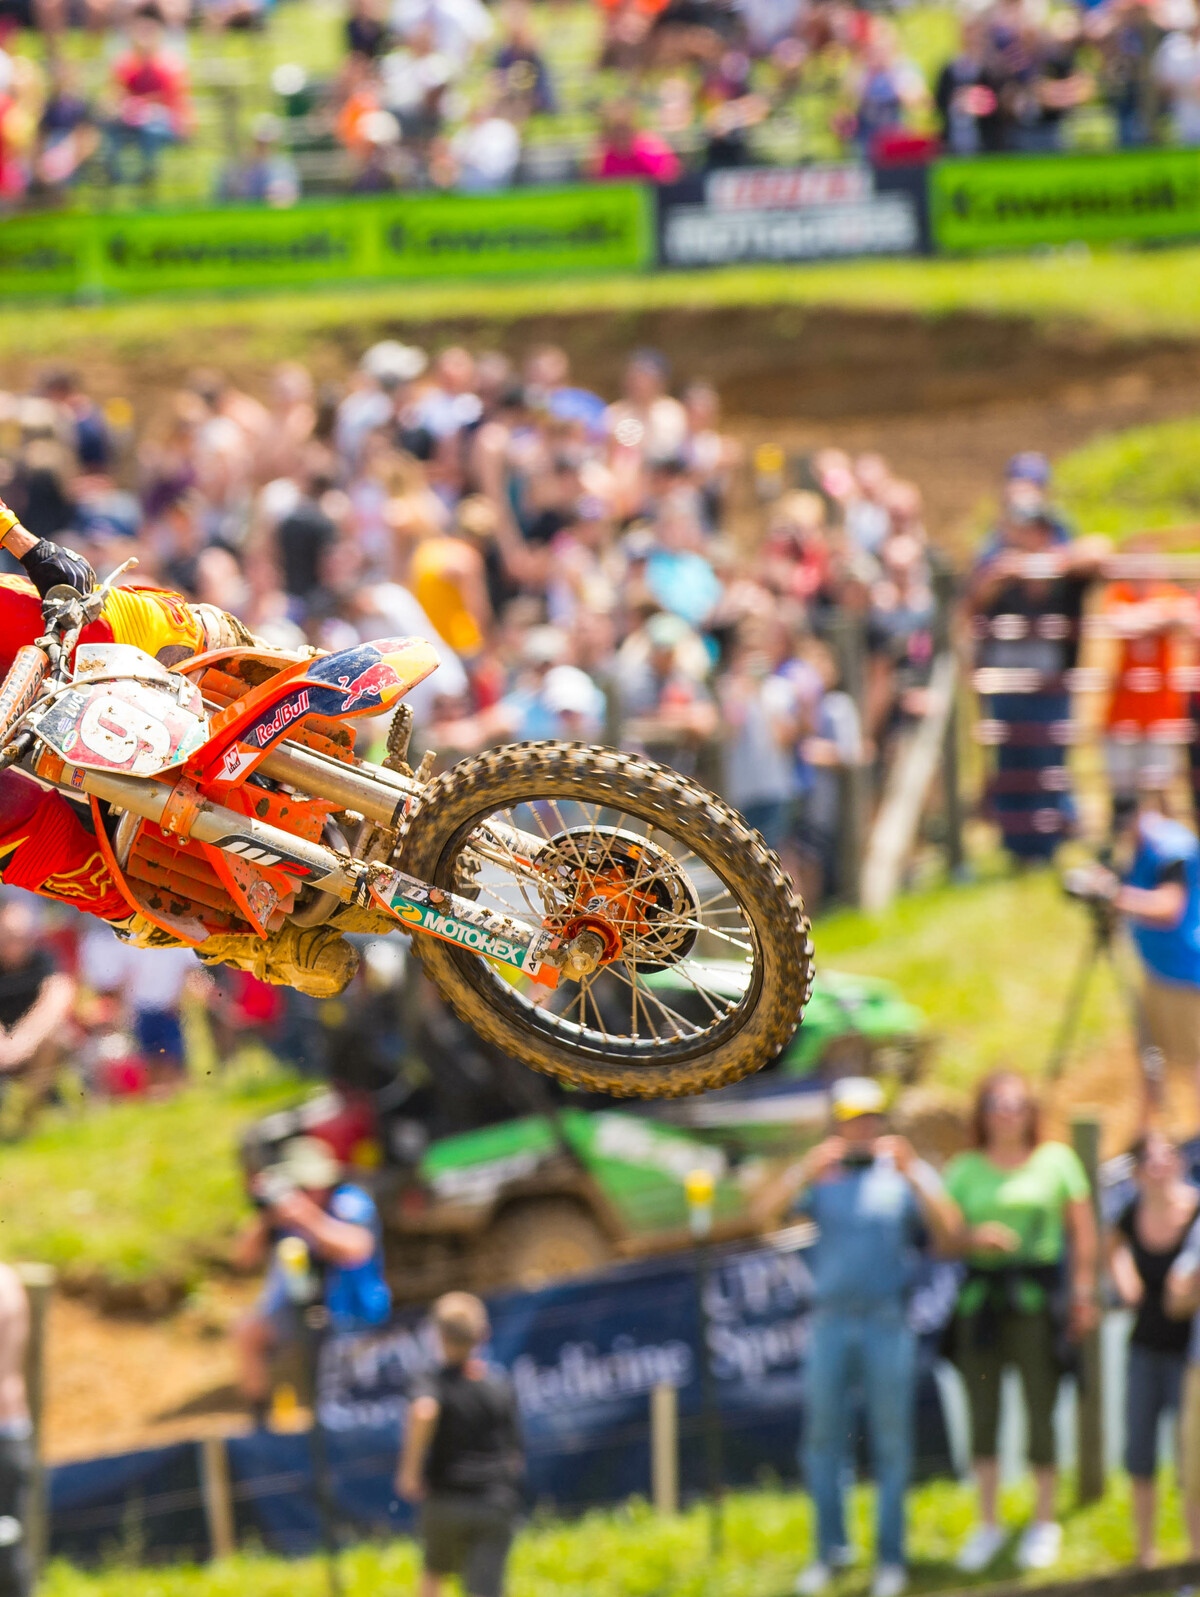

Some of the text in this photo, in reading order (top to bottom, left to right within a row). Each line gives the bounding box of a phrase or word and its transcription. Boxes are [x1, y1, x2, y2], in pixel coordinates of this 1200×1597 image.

[256, 690, 310, 747] Red Bull
[423, 910, 526, 968] MOTOREX
